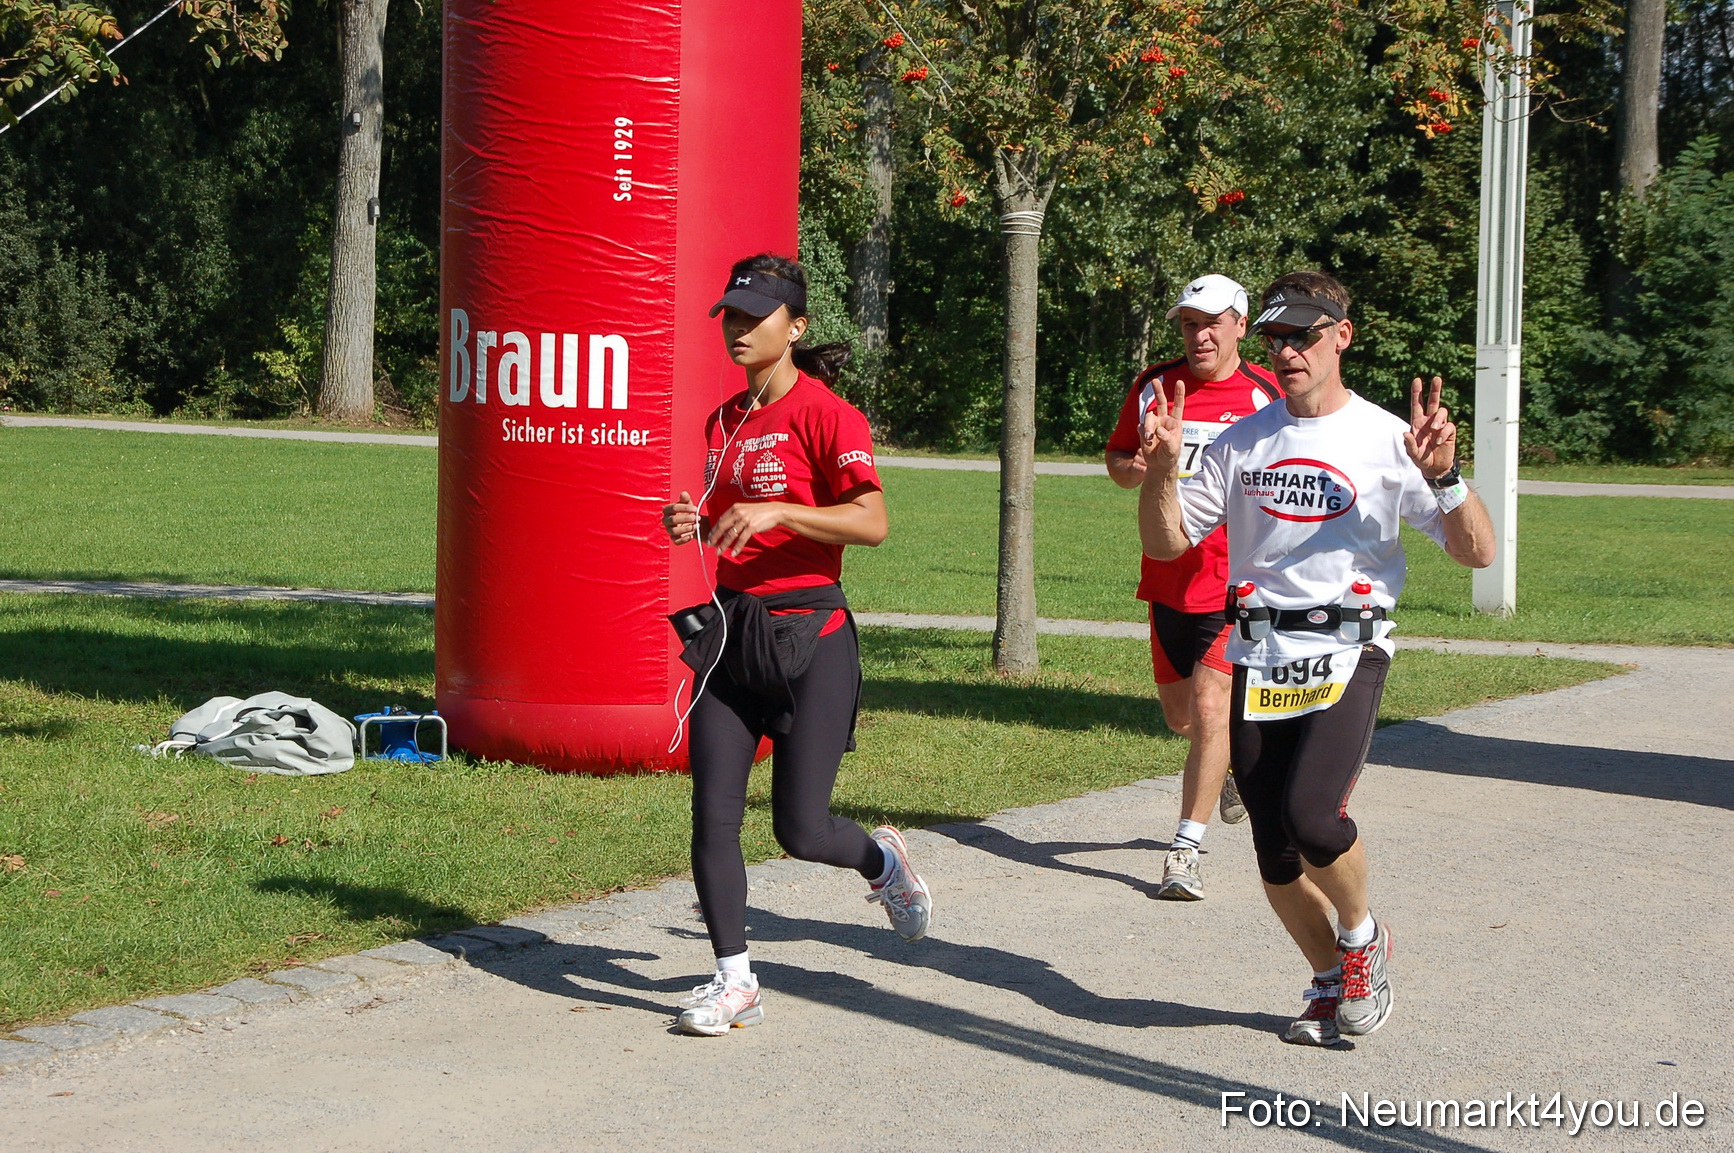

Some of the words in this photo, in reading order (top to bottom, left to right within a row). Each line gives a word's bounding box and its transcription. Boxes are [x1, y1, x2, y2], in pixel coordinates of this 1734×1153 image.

[614, 117, 633, 160] 1929
[613, 168, 632, 202] Seit
[449, 307, 630, 409] Braun
[501, 416, 555, 443] Sicher
[560, 421, 584, 444] ist
[590, 420, 651, 446] sicher
[1240, 471, 1332, 492] GERHART
[1333, 484, 1342, 493] &
[1259, 683, 1334, 708] Bernhard
